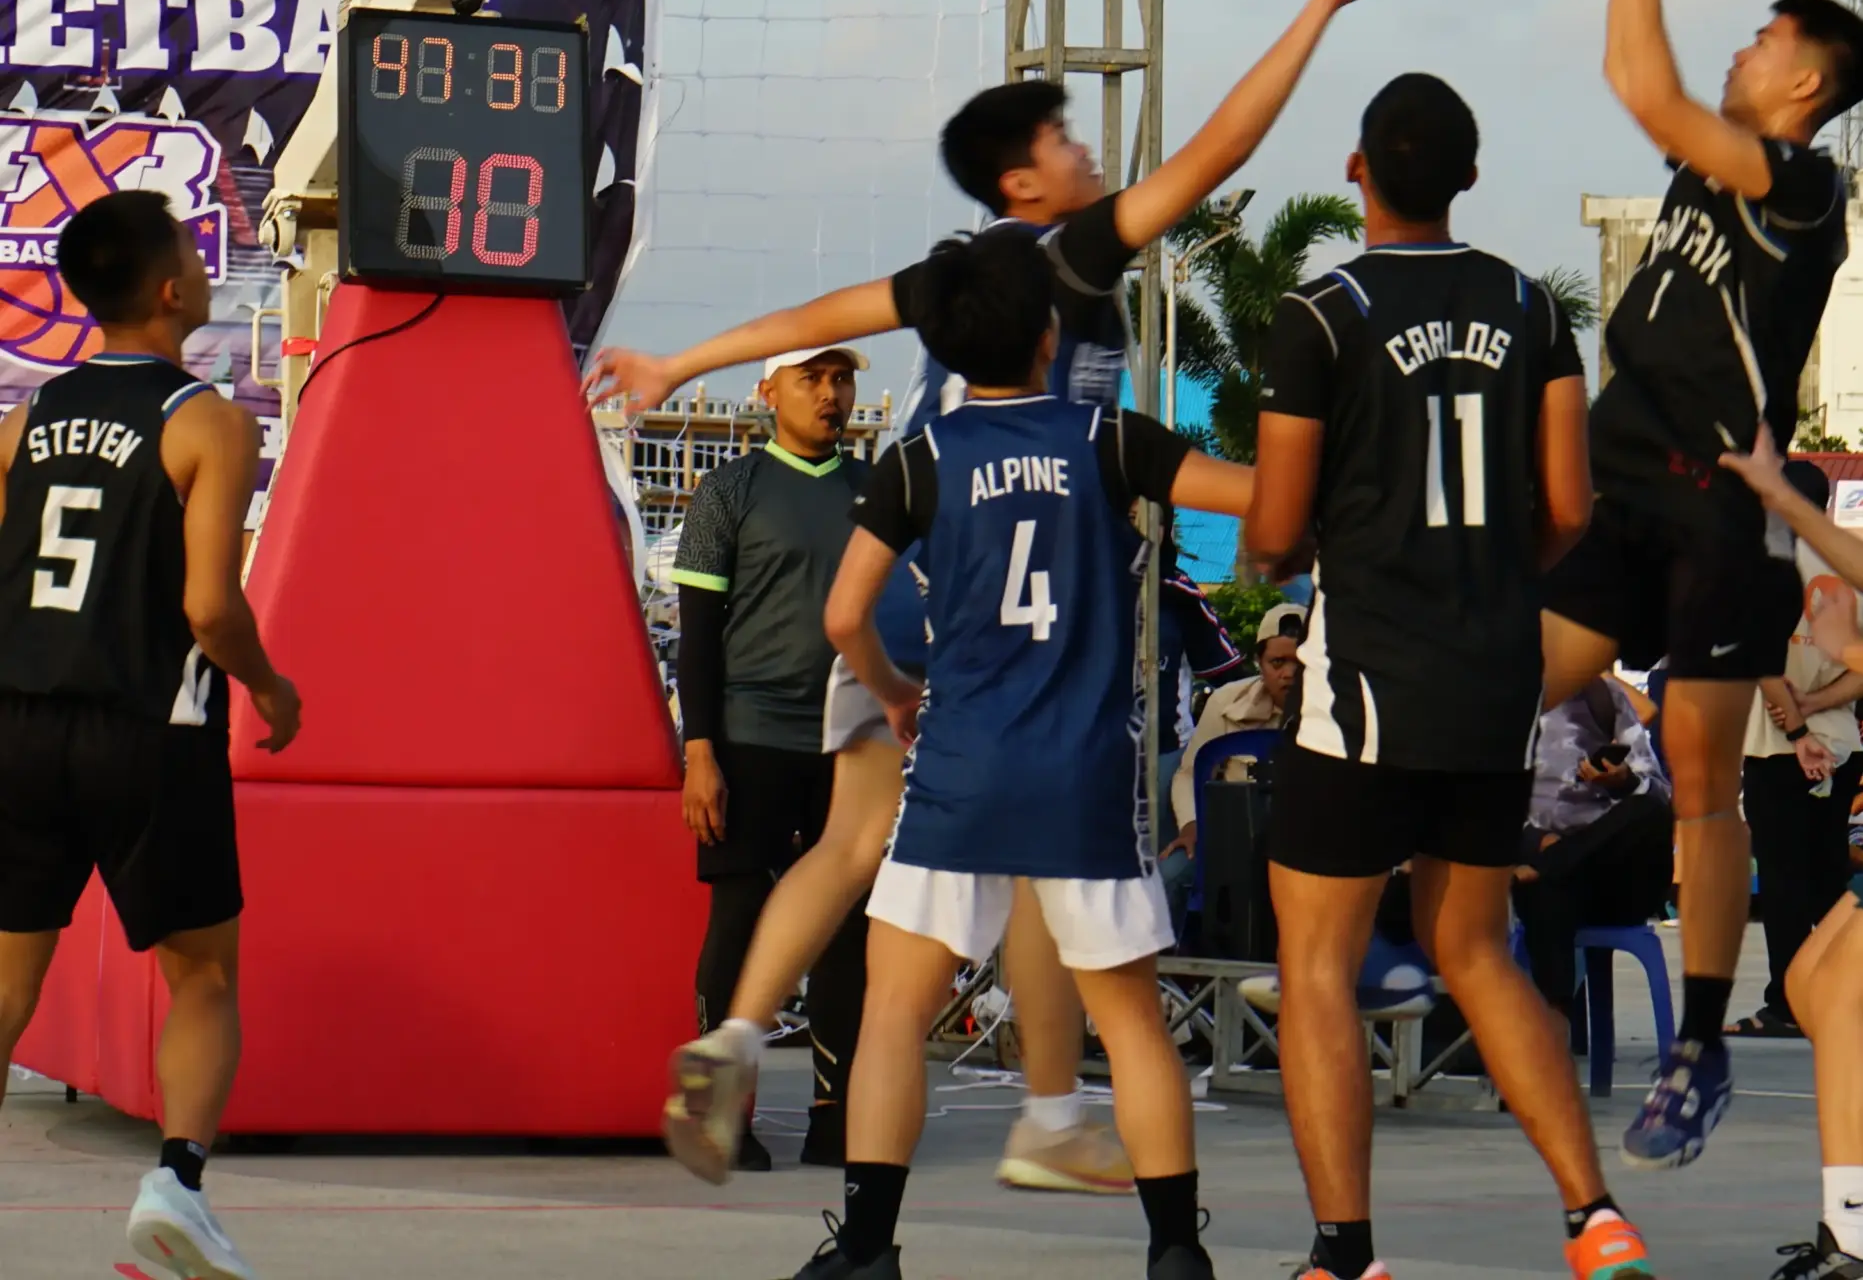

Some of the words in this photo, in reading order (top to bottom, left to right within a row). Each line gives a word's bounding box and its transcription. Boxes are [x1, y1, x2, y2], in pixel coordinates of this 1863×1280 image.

[445, 153, 544, 266] 10
[1385, 320, 1513, 376] CARLOS
[28, 418, 143, 468] STEVEN
[971, 455, 1070, 507] ALPINE
[1426, 393, 1486, 527] 11
[30, 485, 103, 612] 5
[1000, 519, 1057, 641] 4
